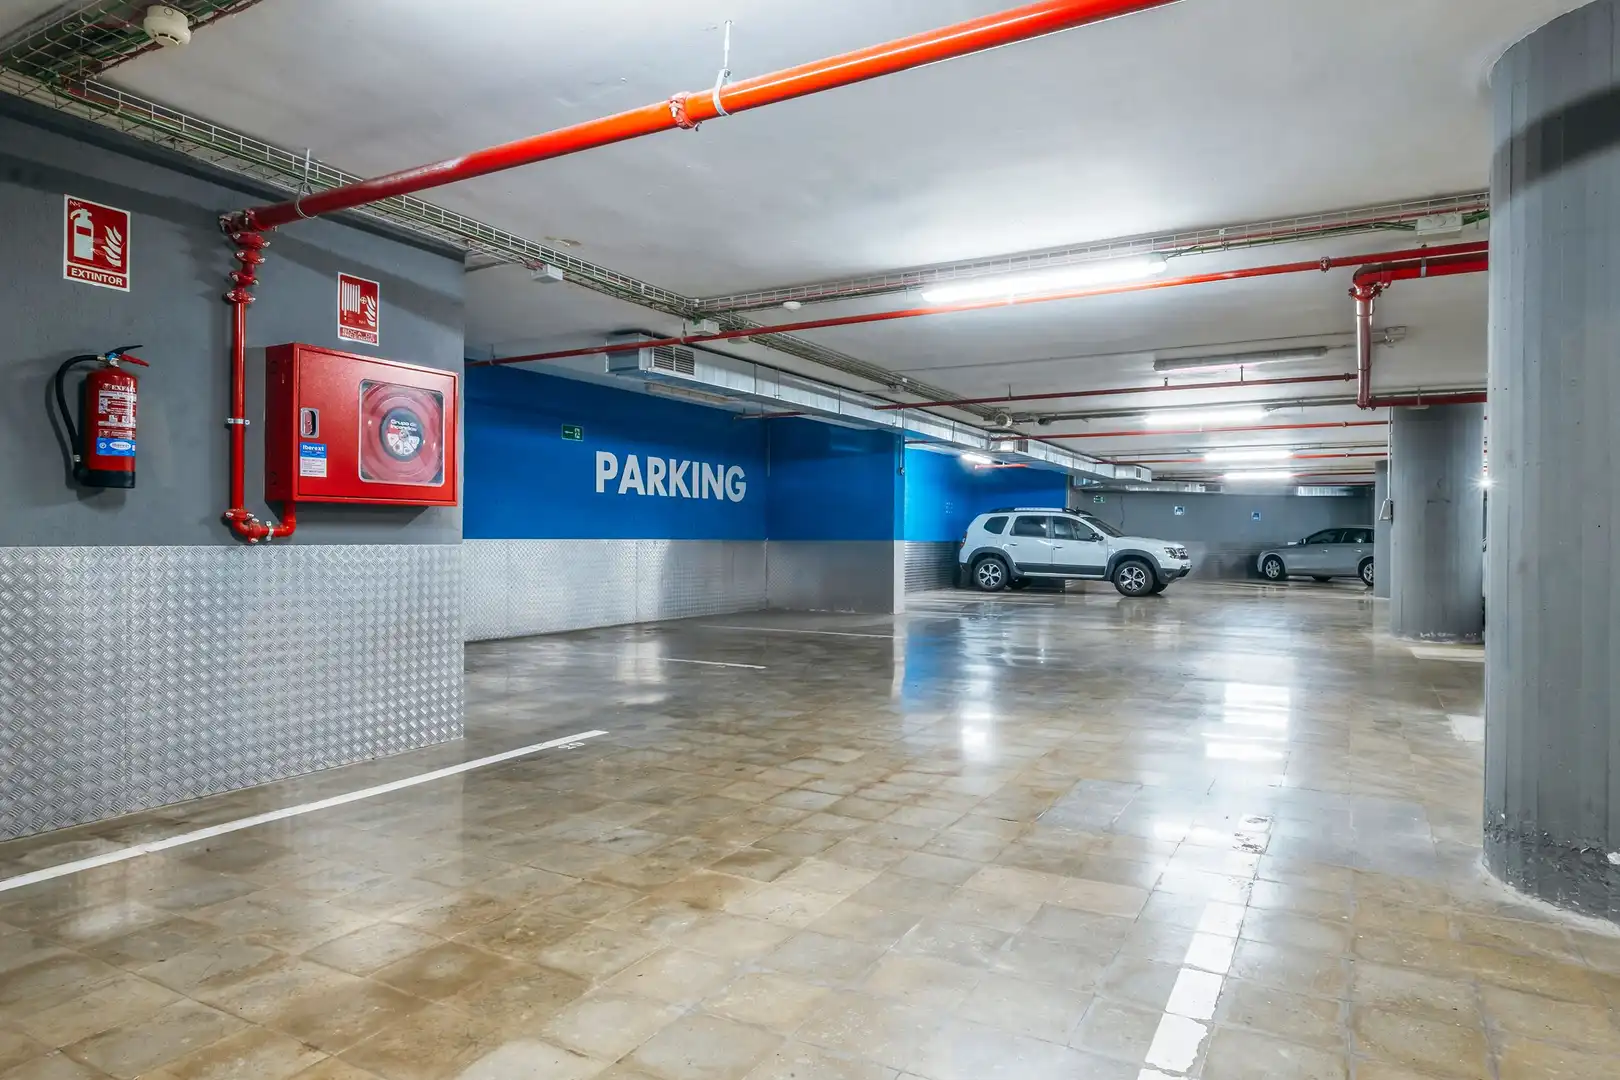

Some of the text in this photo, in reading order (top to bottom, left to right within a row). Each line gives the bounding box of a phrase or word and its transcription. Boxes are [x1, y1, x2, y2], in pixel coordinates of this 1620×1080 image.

[71, 267, 123, 286] EXTINTOR
[342, 327, 362, 336] BOCA
[390, 418, 410, 427] Grupo
[302, 444, 325, 452] Iberext
[595, 450, 747, 503] PARKING
